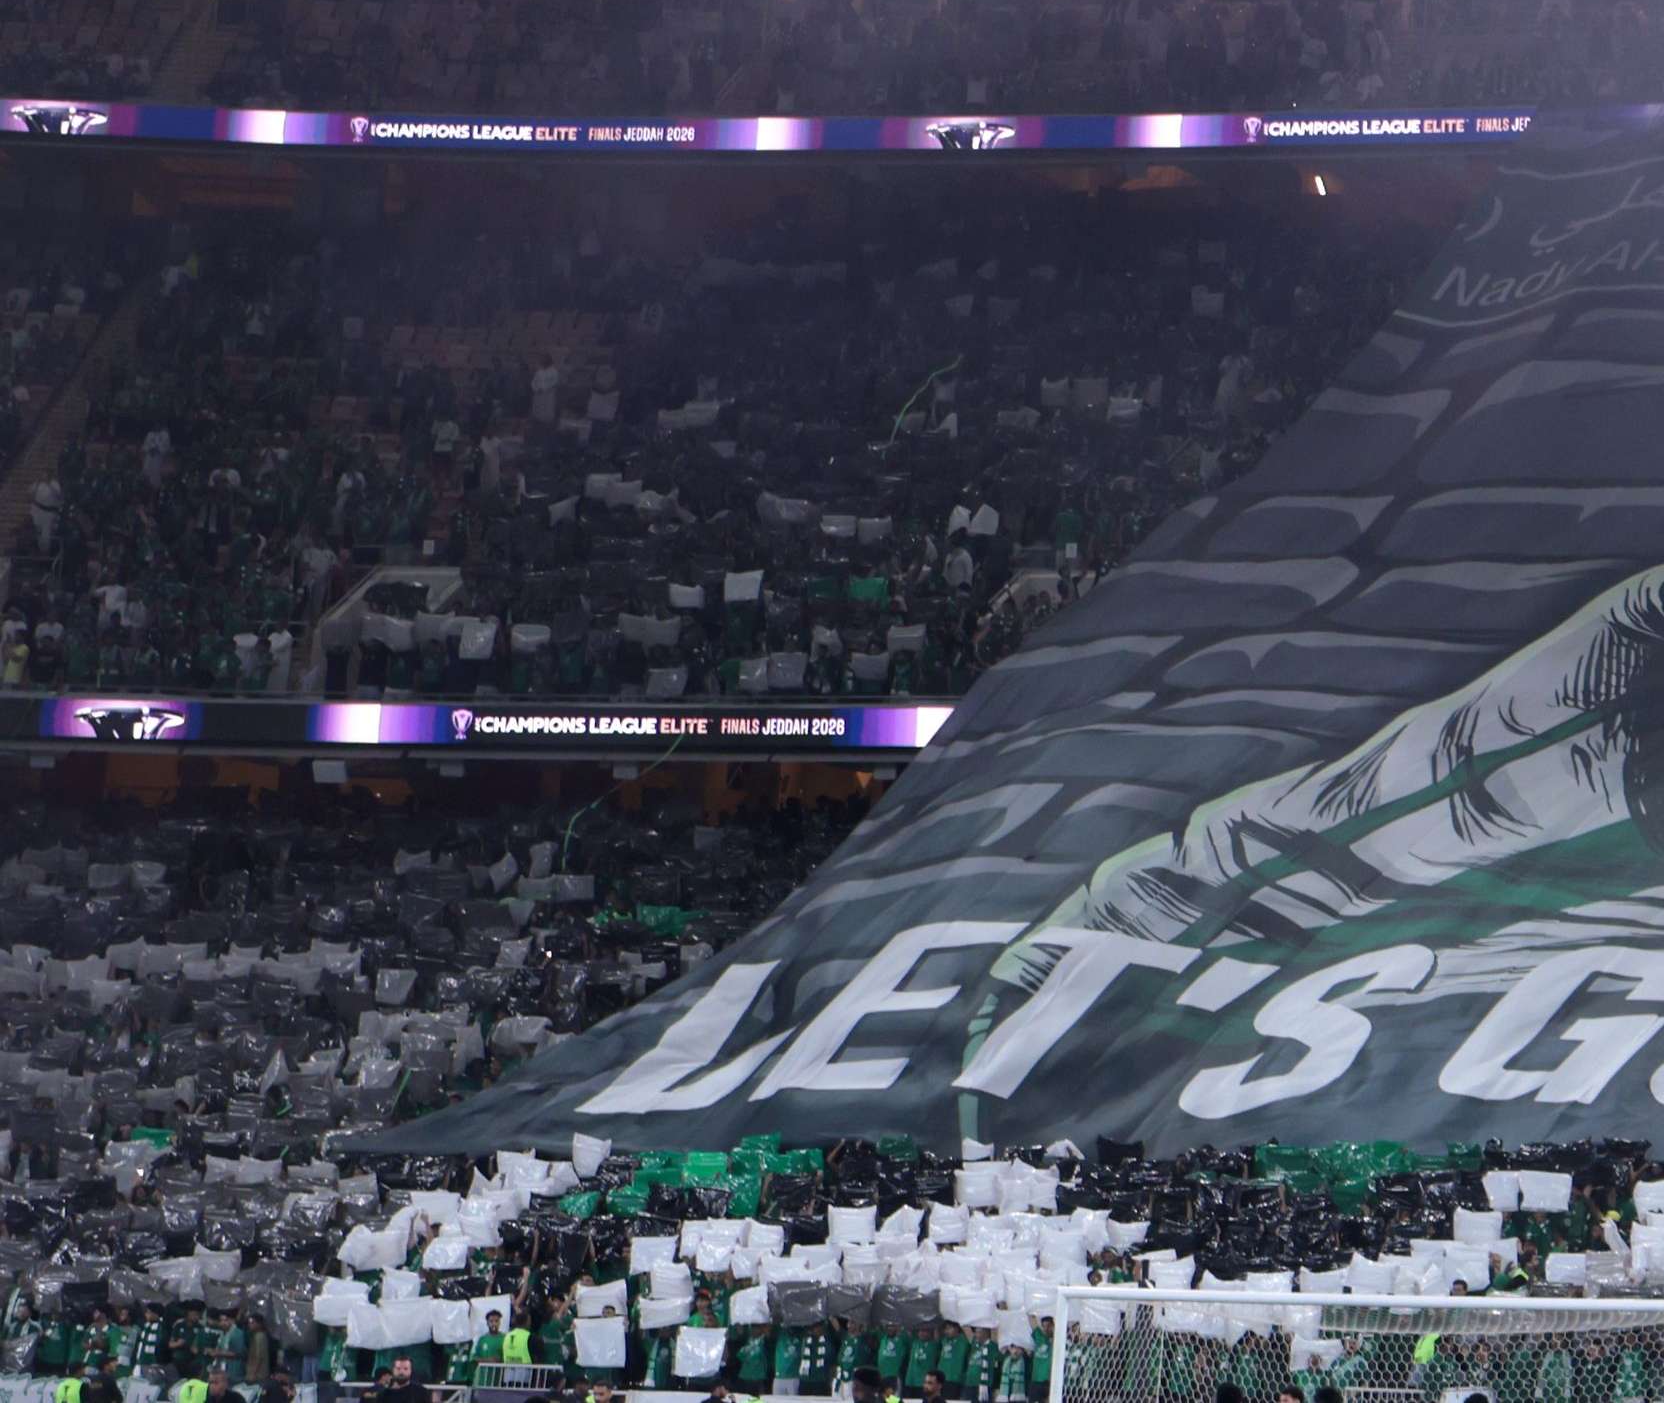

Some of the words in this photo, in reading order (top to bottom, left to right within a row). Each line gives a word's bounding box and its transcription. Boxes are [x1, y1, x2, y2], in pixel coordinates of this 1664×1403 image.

[376, 123, 470, 139] CHAMPIONS
[473, 125, 533, 141] LEAGUE
[535, 127, 577, 141] ELITE
[588, 127, 621, 141] FINALS
[623, 127, 664, 142] JEDDAH
[666, 127, 695, 141] 2026
[1268, 121, 1360, 137] CHAMPIONS
[1362, 119, 1421, 135] LEAGUE
[1423, 119, 1465, 133] ELITE
[1476, 118, 1509, 132] FINALS
[1432, 253, 1587, 307] Nady
[481, 716, 586, 734] CHAMPIONS
[589, 717, 657, 735] LEAGUE
[659, 718, 708, 735] ELITE
[721, 718, 760, 735] FINALS
[762, 718, 808, 735] JEDDAH
[811, 718, 844, 736] 2026
[575, 918, 1437, 1120] LET'S
